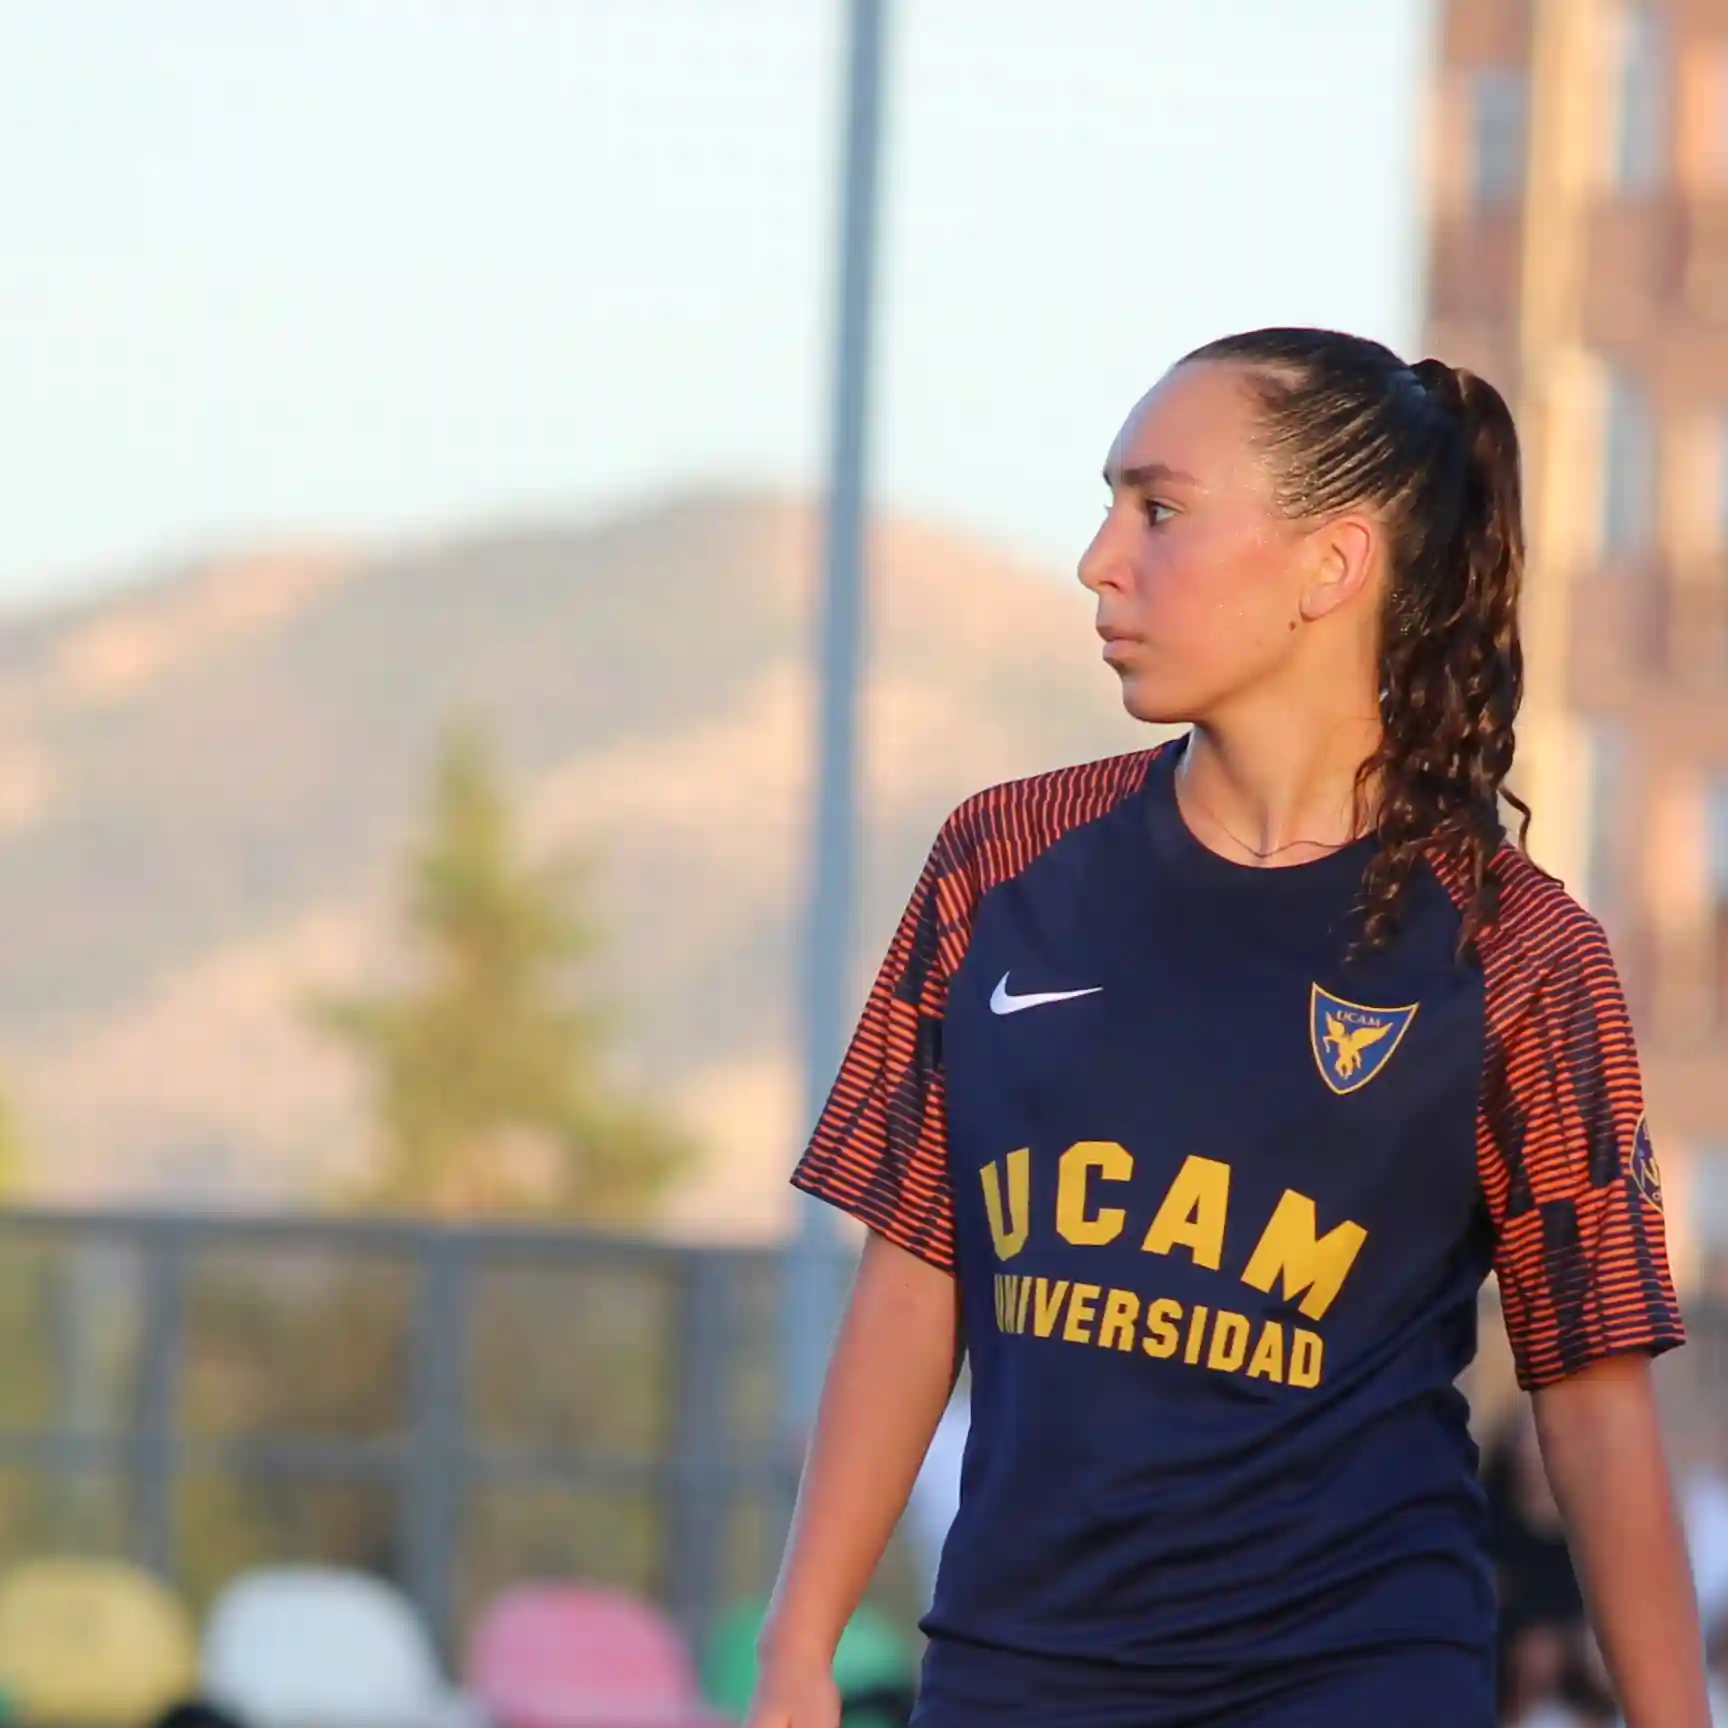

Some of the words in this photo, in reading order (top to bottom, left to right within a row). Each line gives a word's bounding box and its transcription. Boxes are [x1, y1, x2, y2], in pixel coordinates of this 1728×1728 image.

[1336, 1010, 1381, 1028] UCAM
[979, 1140, 1368, 1321] UCAM
[993, 1274, 1325, 1389] UNIVERSIDAD
